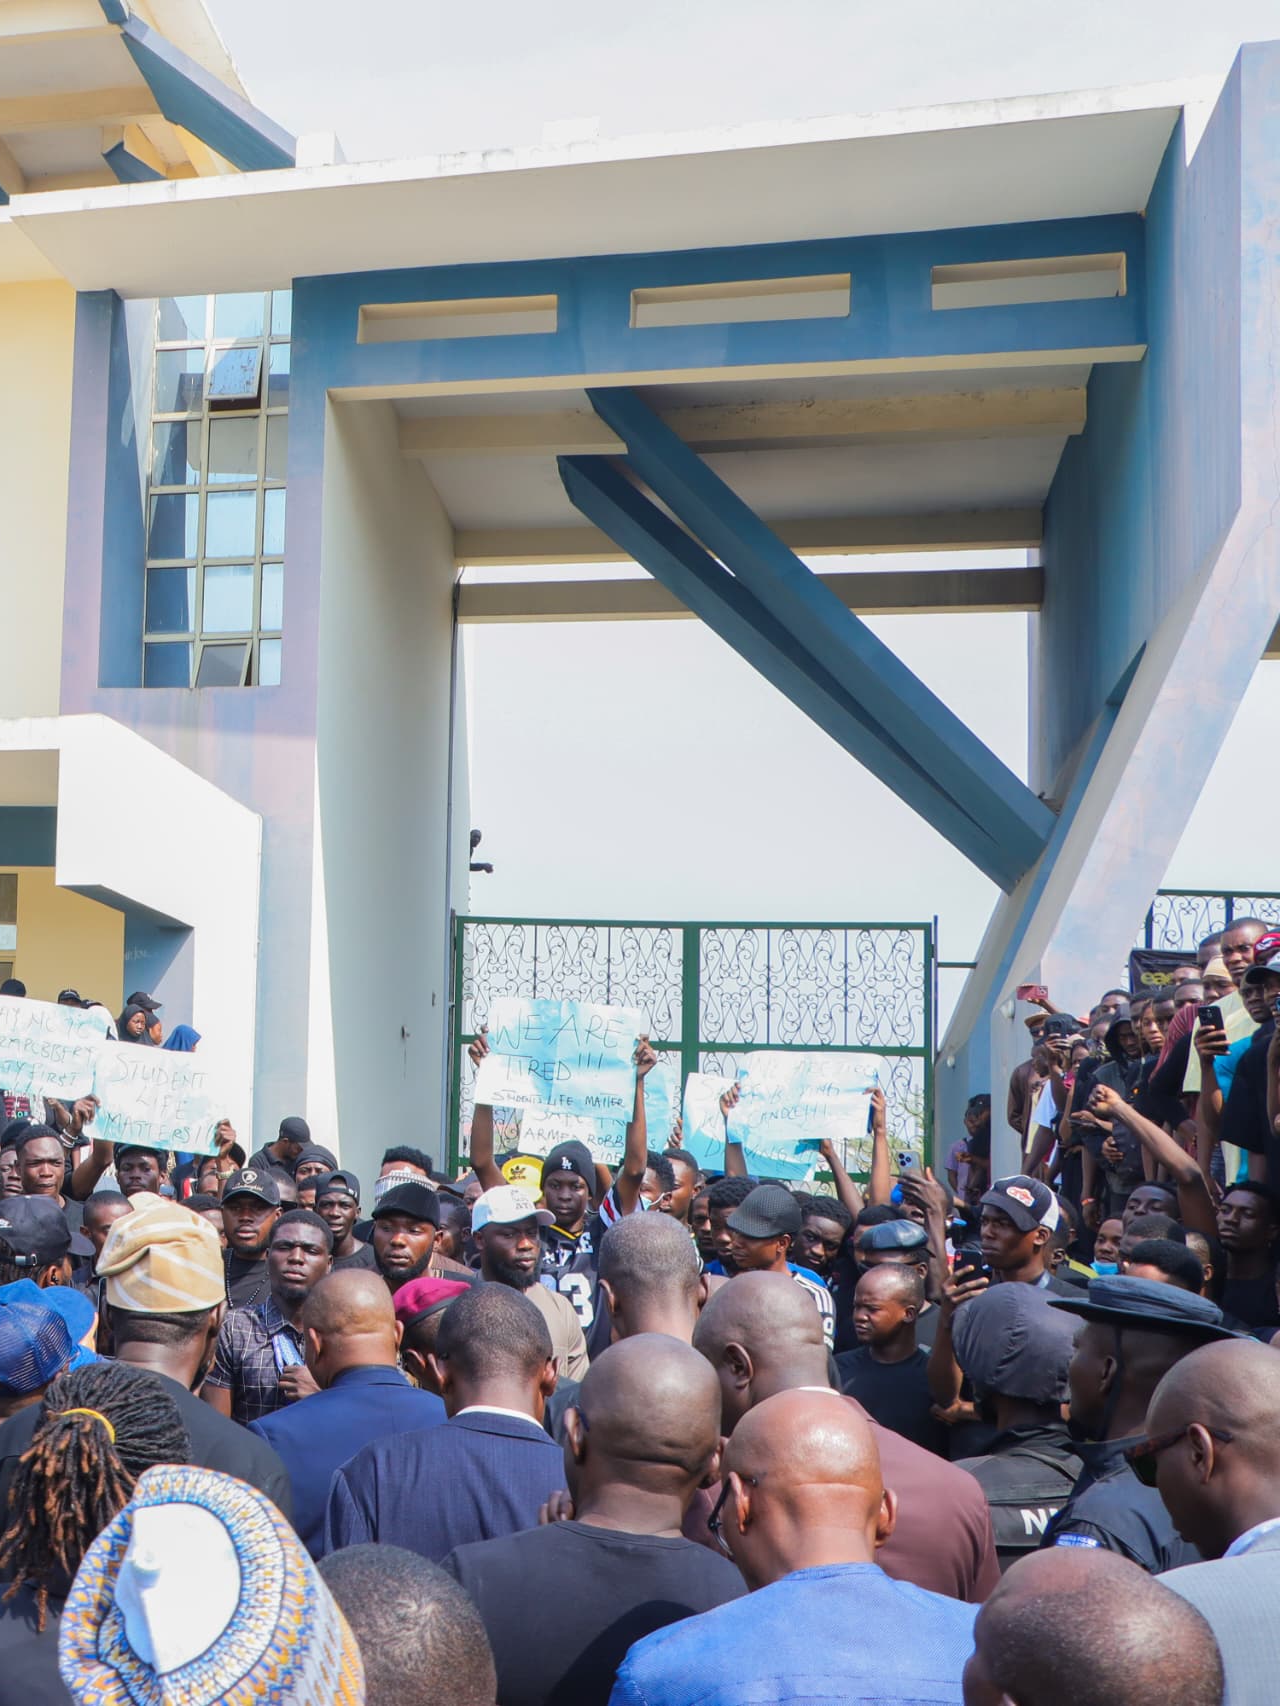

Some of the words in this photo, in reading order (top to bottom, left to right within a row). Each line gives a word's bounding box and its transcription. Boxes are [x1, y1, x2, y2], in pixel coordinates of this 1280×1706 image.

[495, 1007, 545, 1050] WE
[548, 1013, 625, 1049] ARE
[107, 1052, 209, 1092] STUDENT
[135, 1083, 190, 1121] LIFE
[546, 1094, 574, 1107] LIFE
[584, 1092, 625, 1109] MATTER
